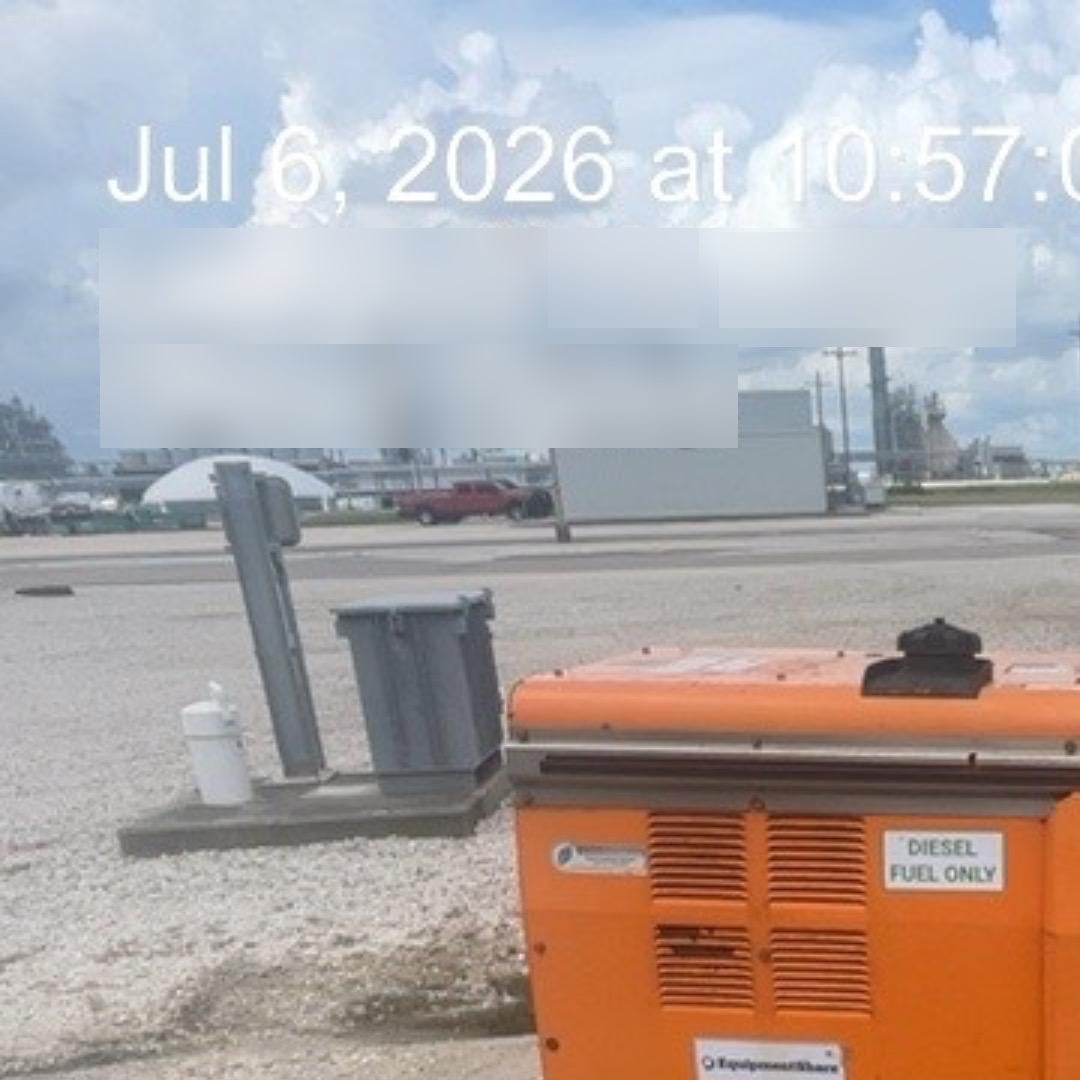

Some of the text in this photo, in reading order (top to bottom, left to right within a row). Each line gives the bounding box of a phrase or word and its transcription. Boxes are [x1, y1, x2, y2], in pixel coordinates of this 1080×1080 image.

[907, 838, 979, 857] DIESEL
[889, 863, 997, 883] FUEL ONLY
